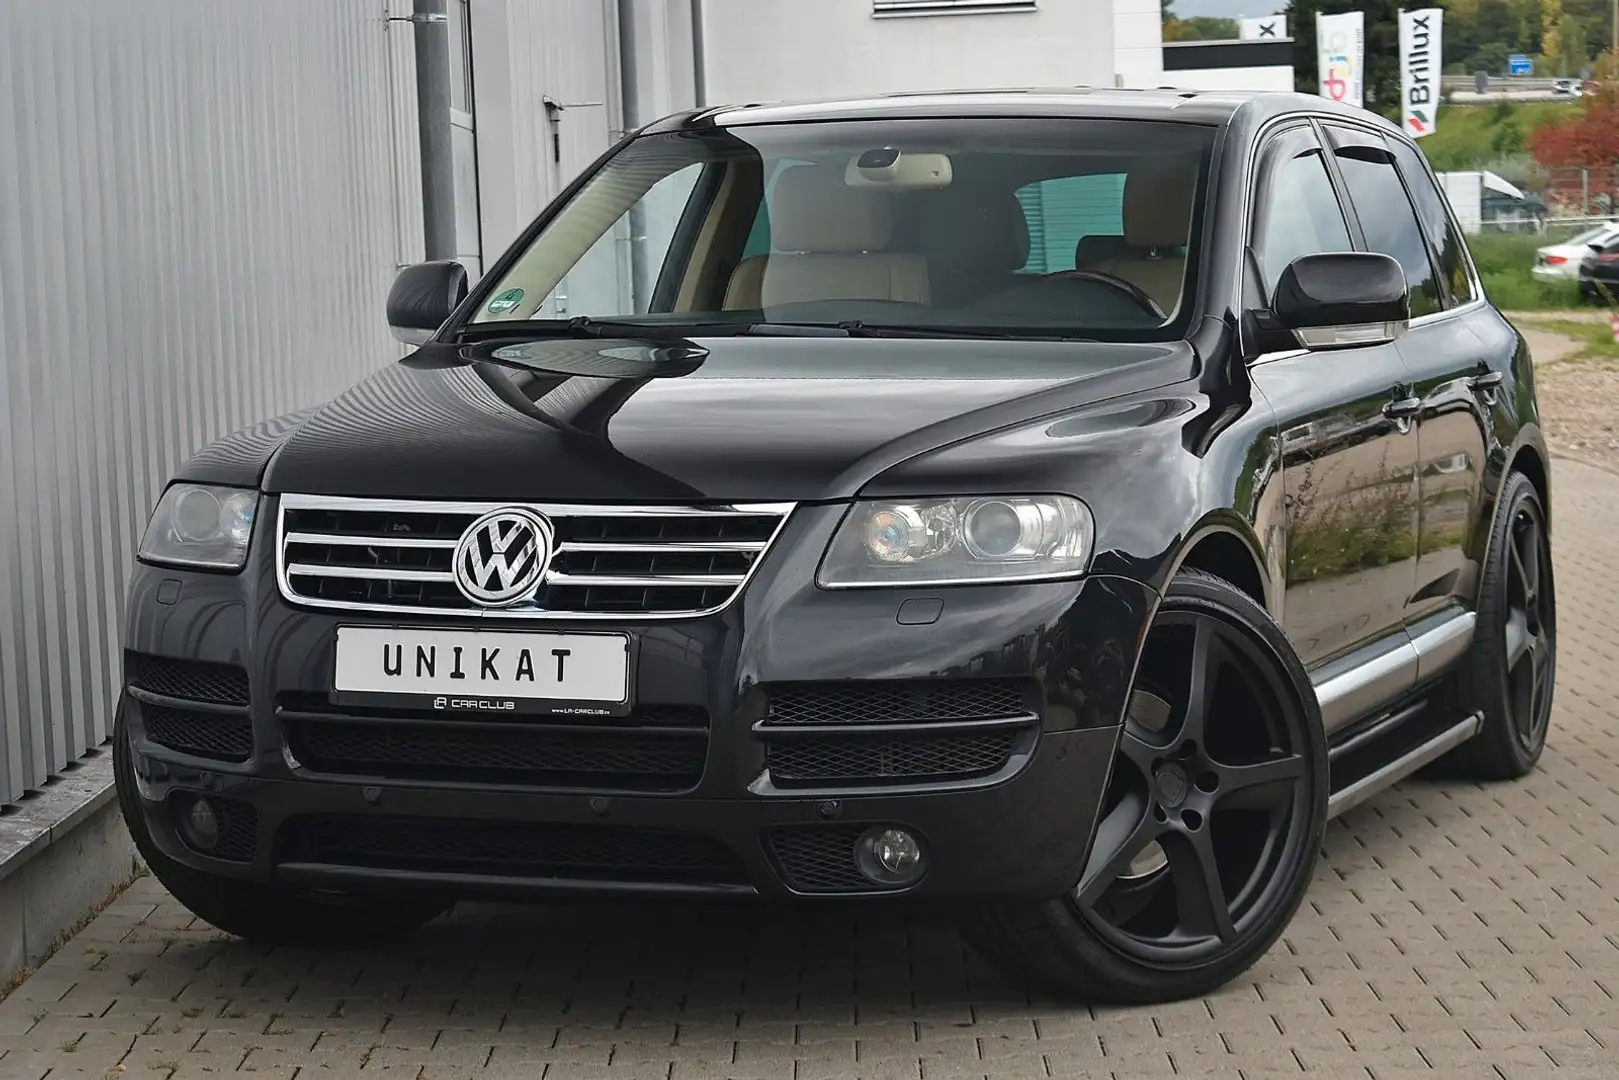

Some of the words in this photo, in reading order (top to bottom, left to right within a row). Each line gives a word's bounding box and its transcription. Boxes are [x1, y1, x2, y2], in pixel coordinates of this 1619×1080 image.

[1408, 15, 1430, 105] Brillux
[383, 643, 571, 683] UNIKAT
[451, 700, 515, 711] CARCLUB
